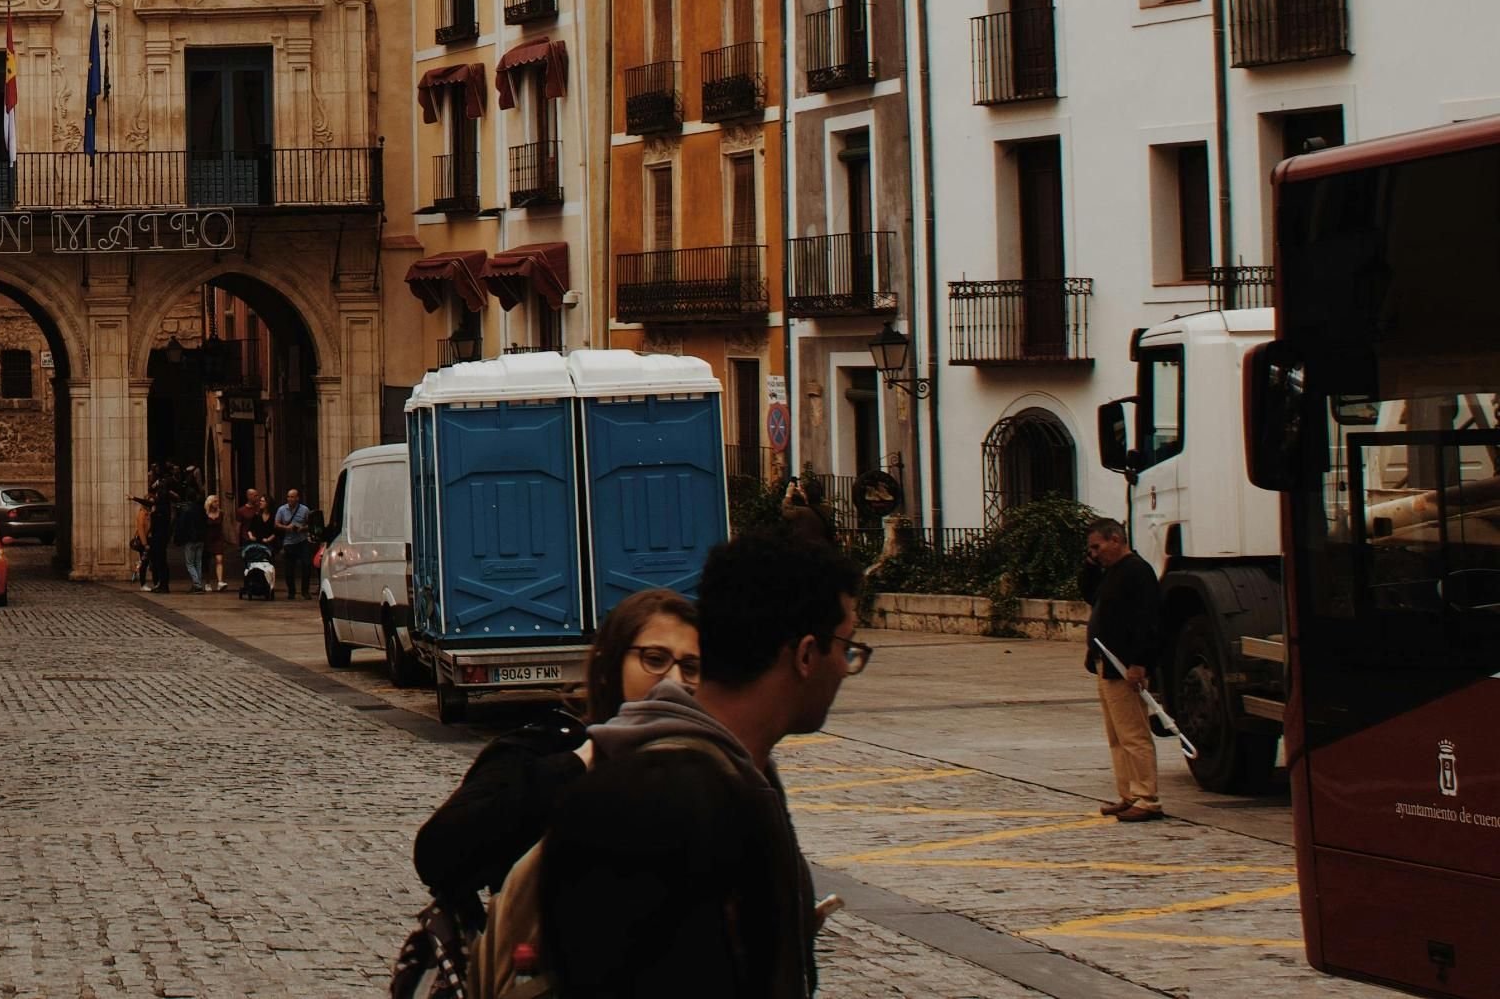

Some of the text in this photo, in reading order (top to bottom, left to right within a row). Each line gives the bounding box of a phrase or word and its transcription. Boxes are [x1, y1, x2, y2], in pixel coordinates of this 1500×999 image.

[54, 211, 232, 250] MATEO
[501, 668, 531, 681] 9049
[1395, 802, 1458, 821] ayuntamiento
[1460, 806, 1472, 824] de
